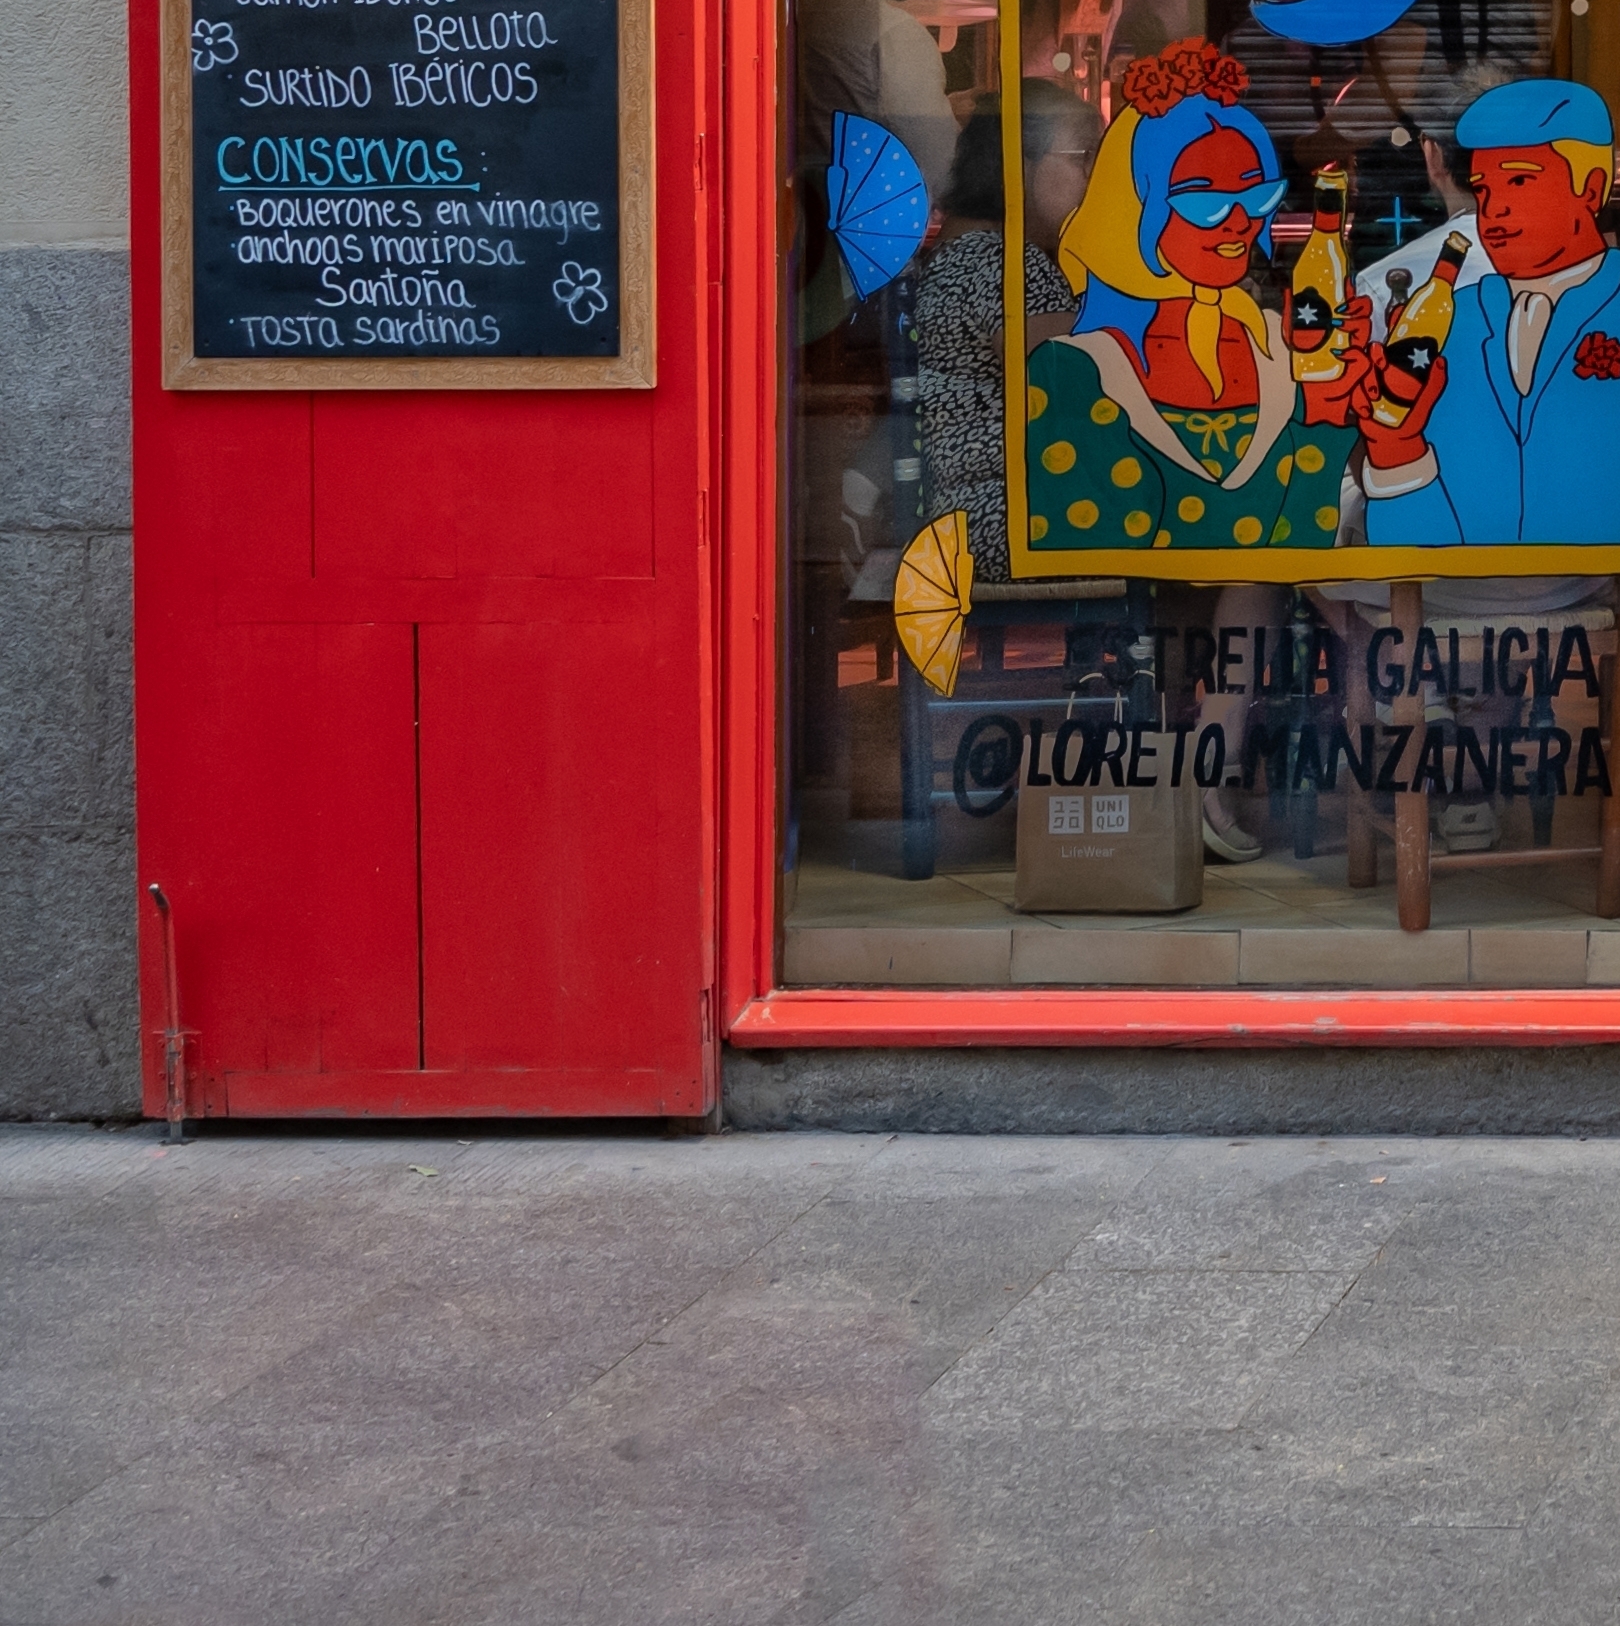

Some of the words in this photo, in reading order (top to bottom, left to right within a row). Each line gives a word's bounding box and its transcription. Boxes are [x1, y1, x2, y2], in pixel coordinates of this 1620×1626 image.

[436, 199, 471, 227] en
[481, 192, 601, 245] vinagre
[237, 230, 364, 264] anchoas
[370, 230, 526, 265] mariposa
[316, 267, 476, 308] Santoña
[354, 310, 500, 346] sardinas
[1365, 626, 1601, 700] GALICIA
[952, 714, 1615, 819] @LORETO.MANZANERA
[1096, 800, 1123, 813] UNI
[1096, 815, 1125, 830] QLO
[1061, 846, 1115, 859] LifeWear
